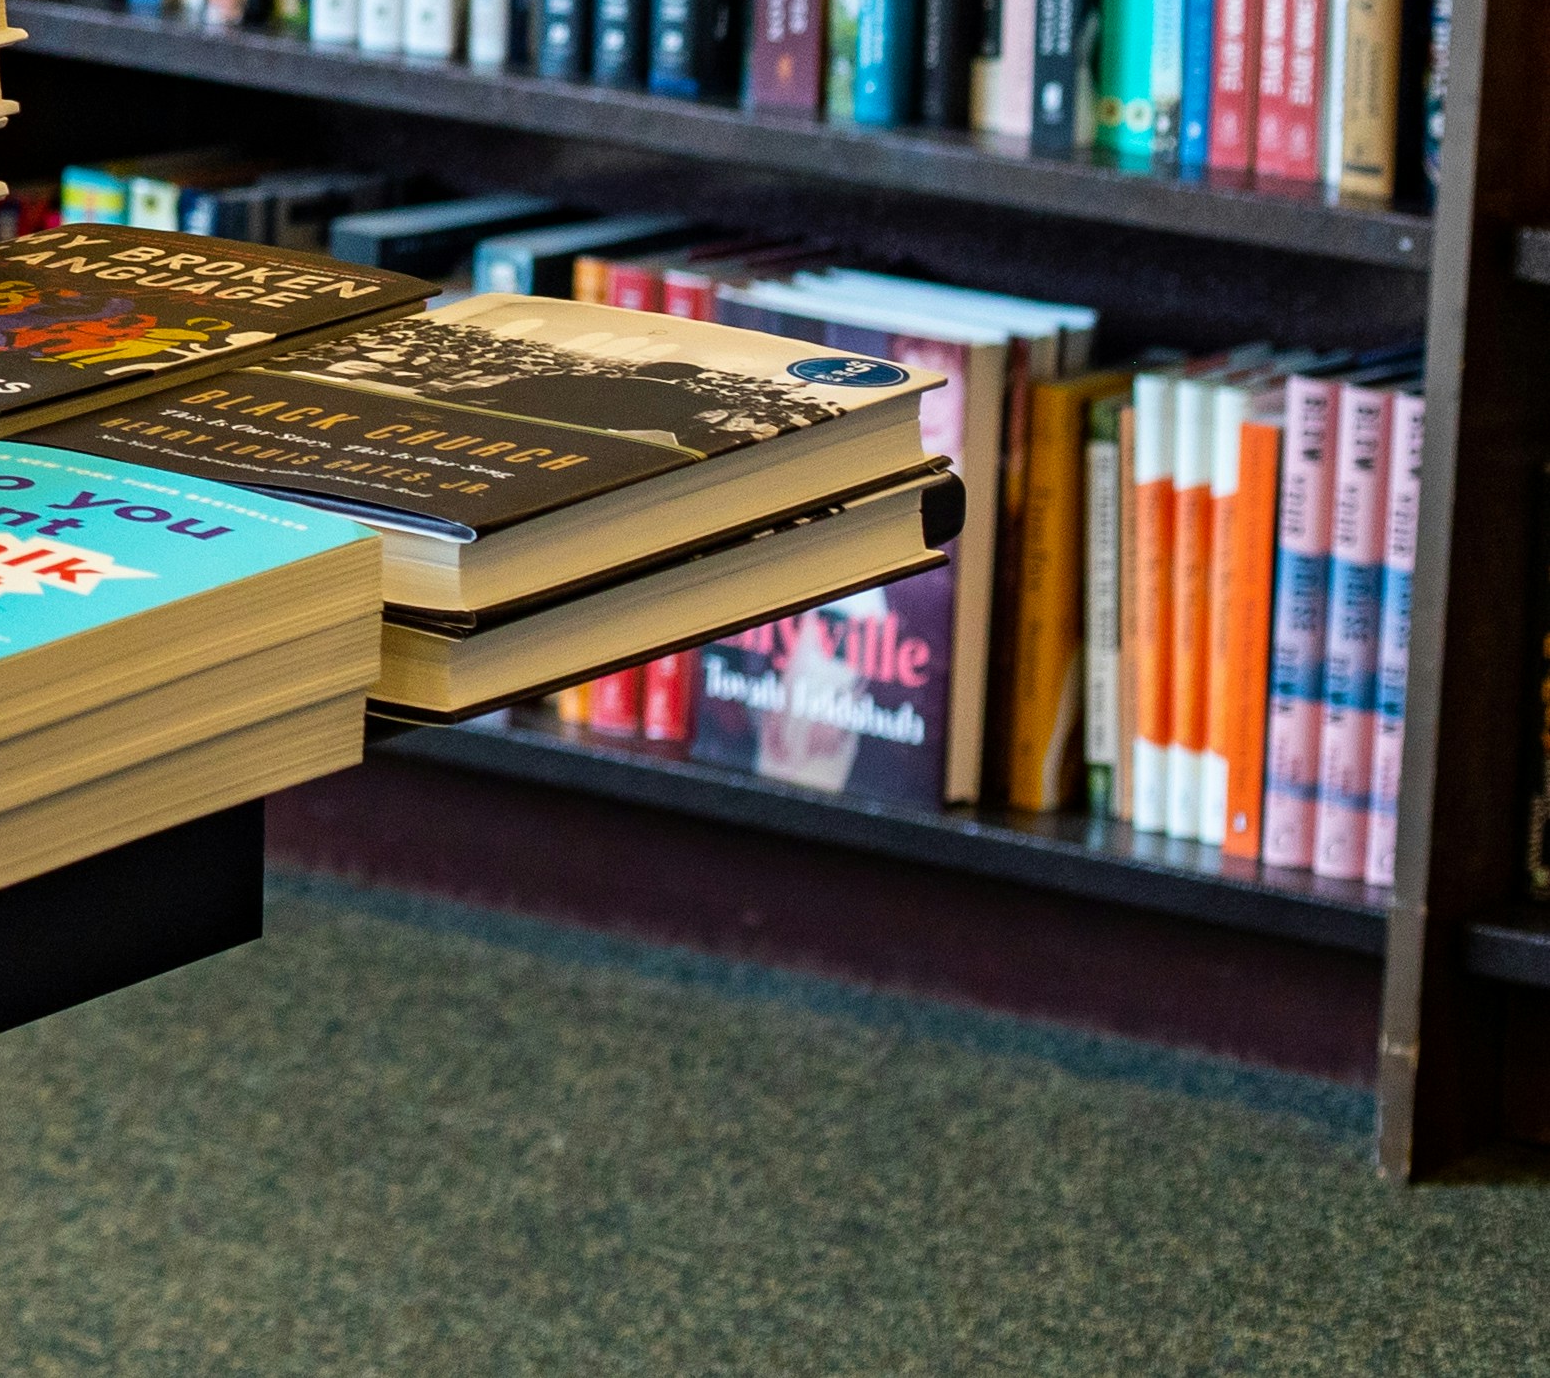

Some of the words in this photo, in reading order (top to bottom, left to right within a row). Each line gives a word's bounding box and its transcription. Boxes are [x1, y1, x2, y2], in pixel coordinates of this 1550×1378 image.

[16, 231, 111, 247] MY
[107, 247, 383, 300] BROKEN
[99, 416, 212, 446] HENRY
[214, 440, 319, 467] LOUIS
[180, 389, 359, 431] BLACK
[363, 423, 589, 472] CHURCH
[44, 488, 235, 543] you
